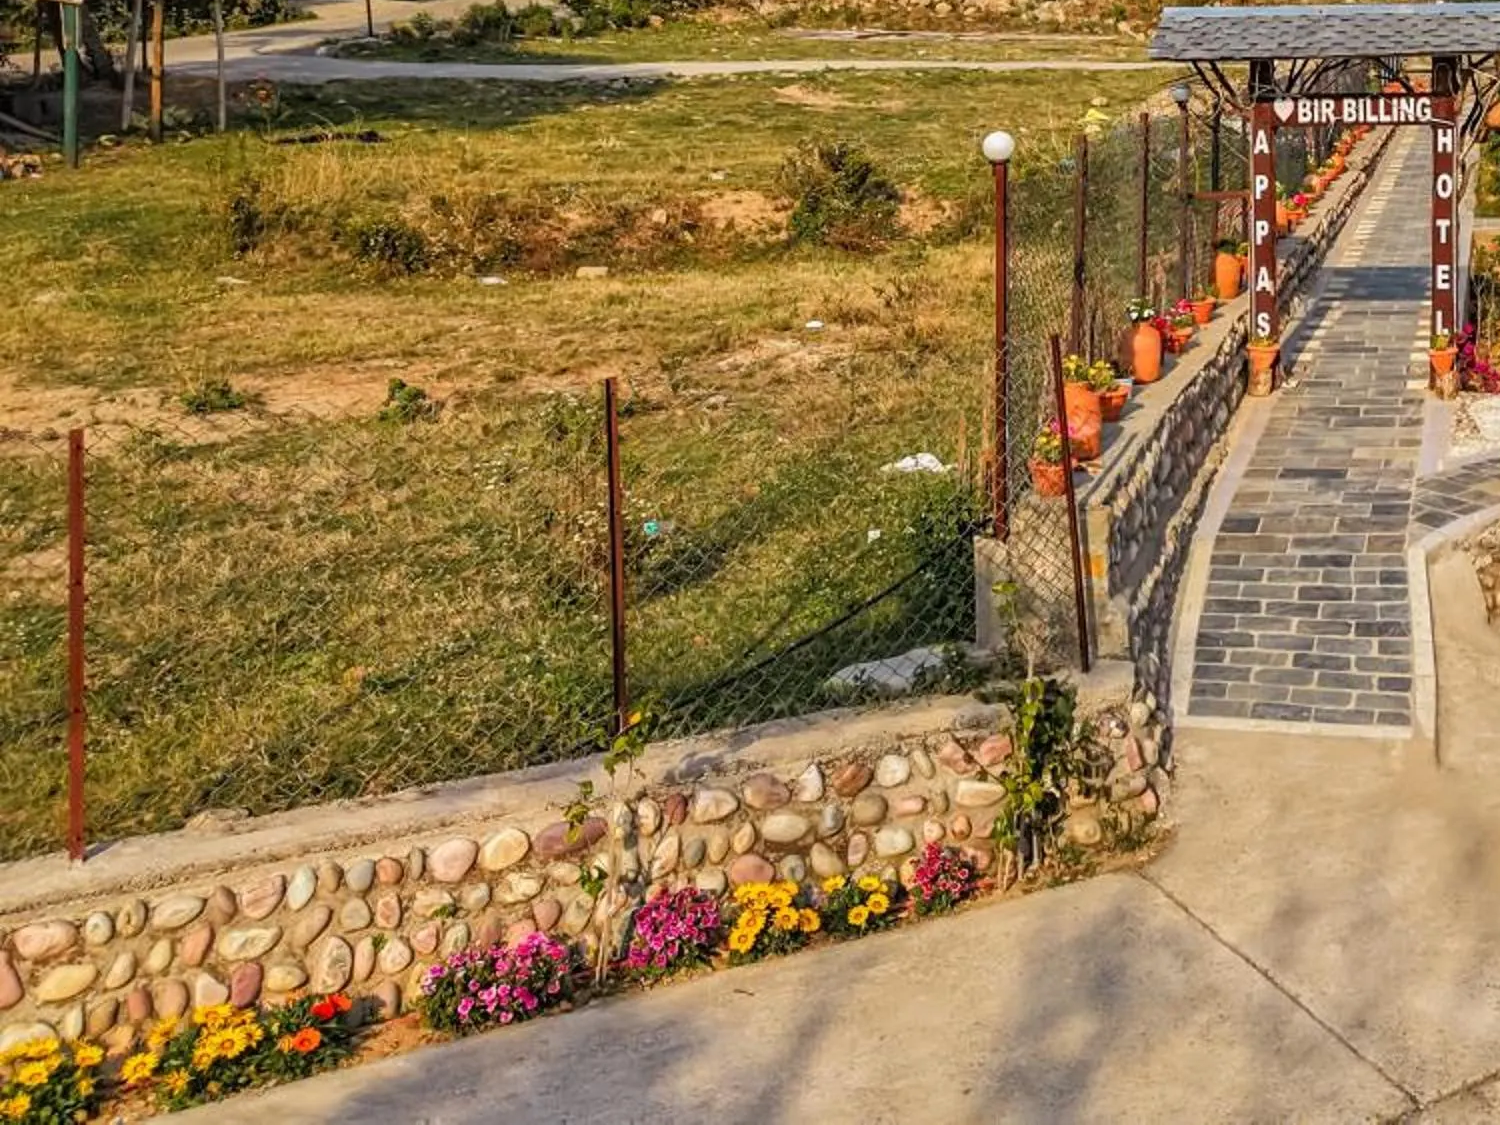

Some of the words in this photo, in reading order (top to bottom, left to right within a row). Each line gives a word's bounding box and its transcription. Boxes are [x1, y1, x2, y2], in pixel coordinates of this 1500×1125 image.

[1298, 97, 1335, 123] BIR
[1343, 96, 1432, 123] BILLING
[1253, 130, 1272, 337] APPAS
[1435, 128, 1453, 335] HOTEL
